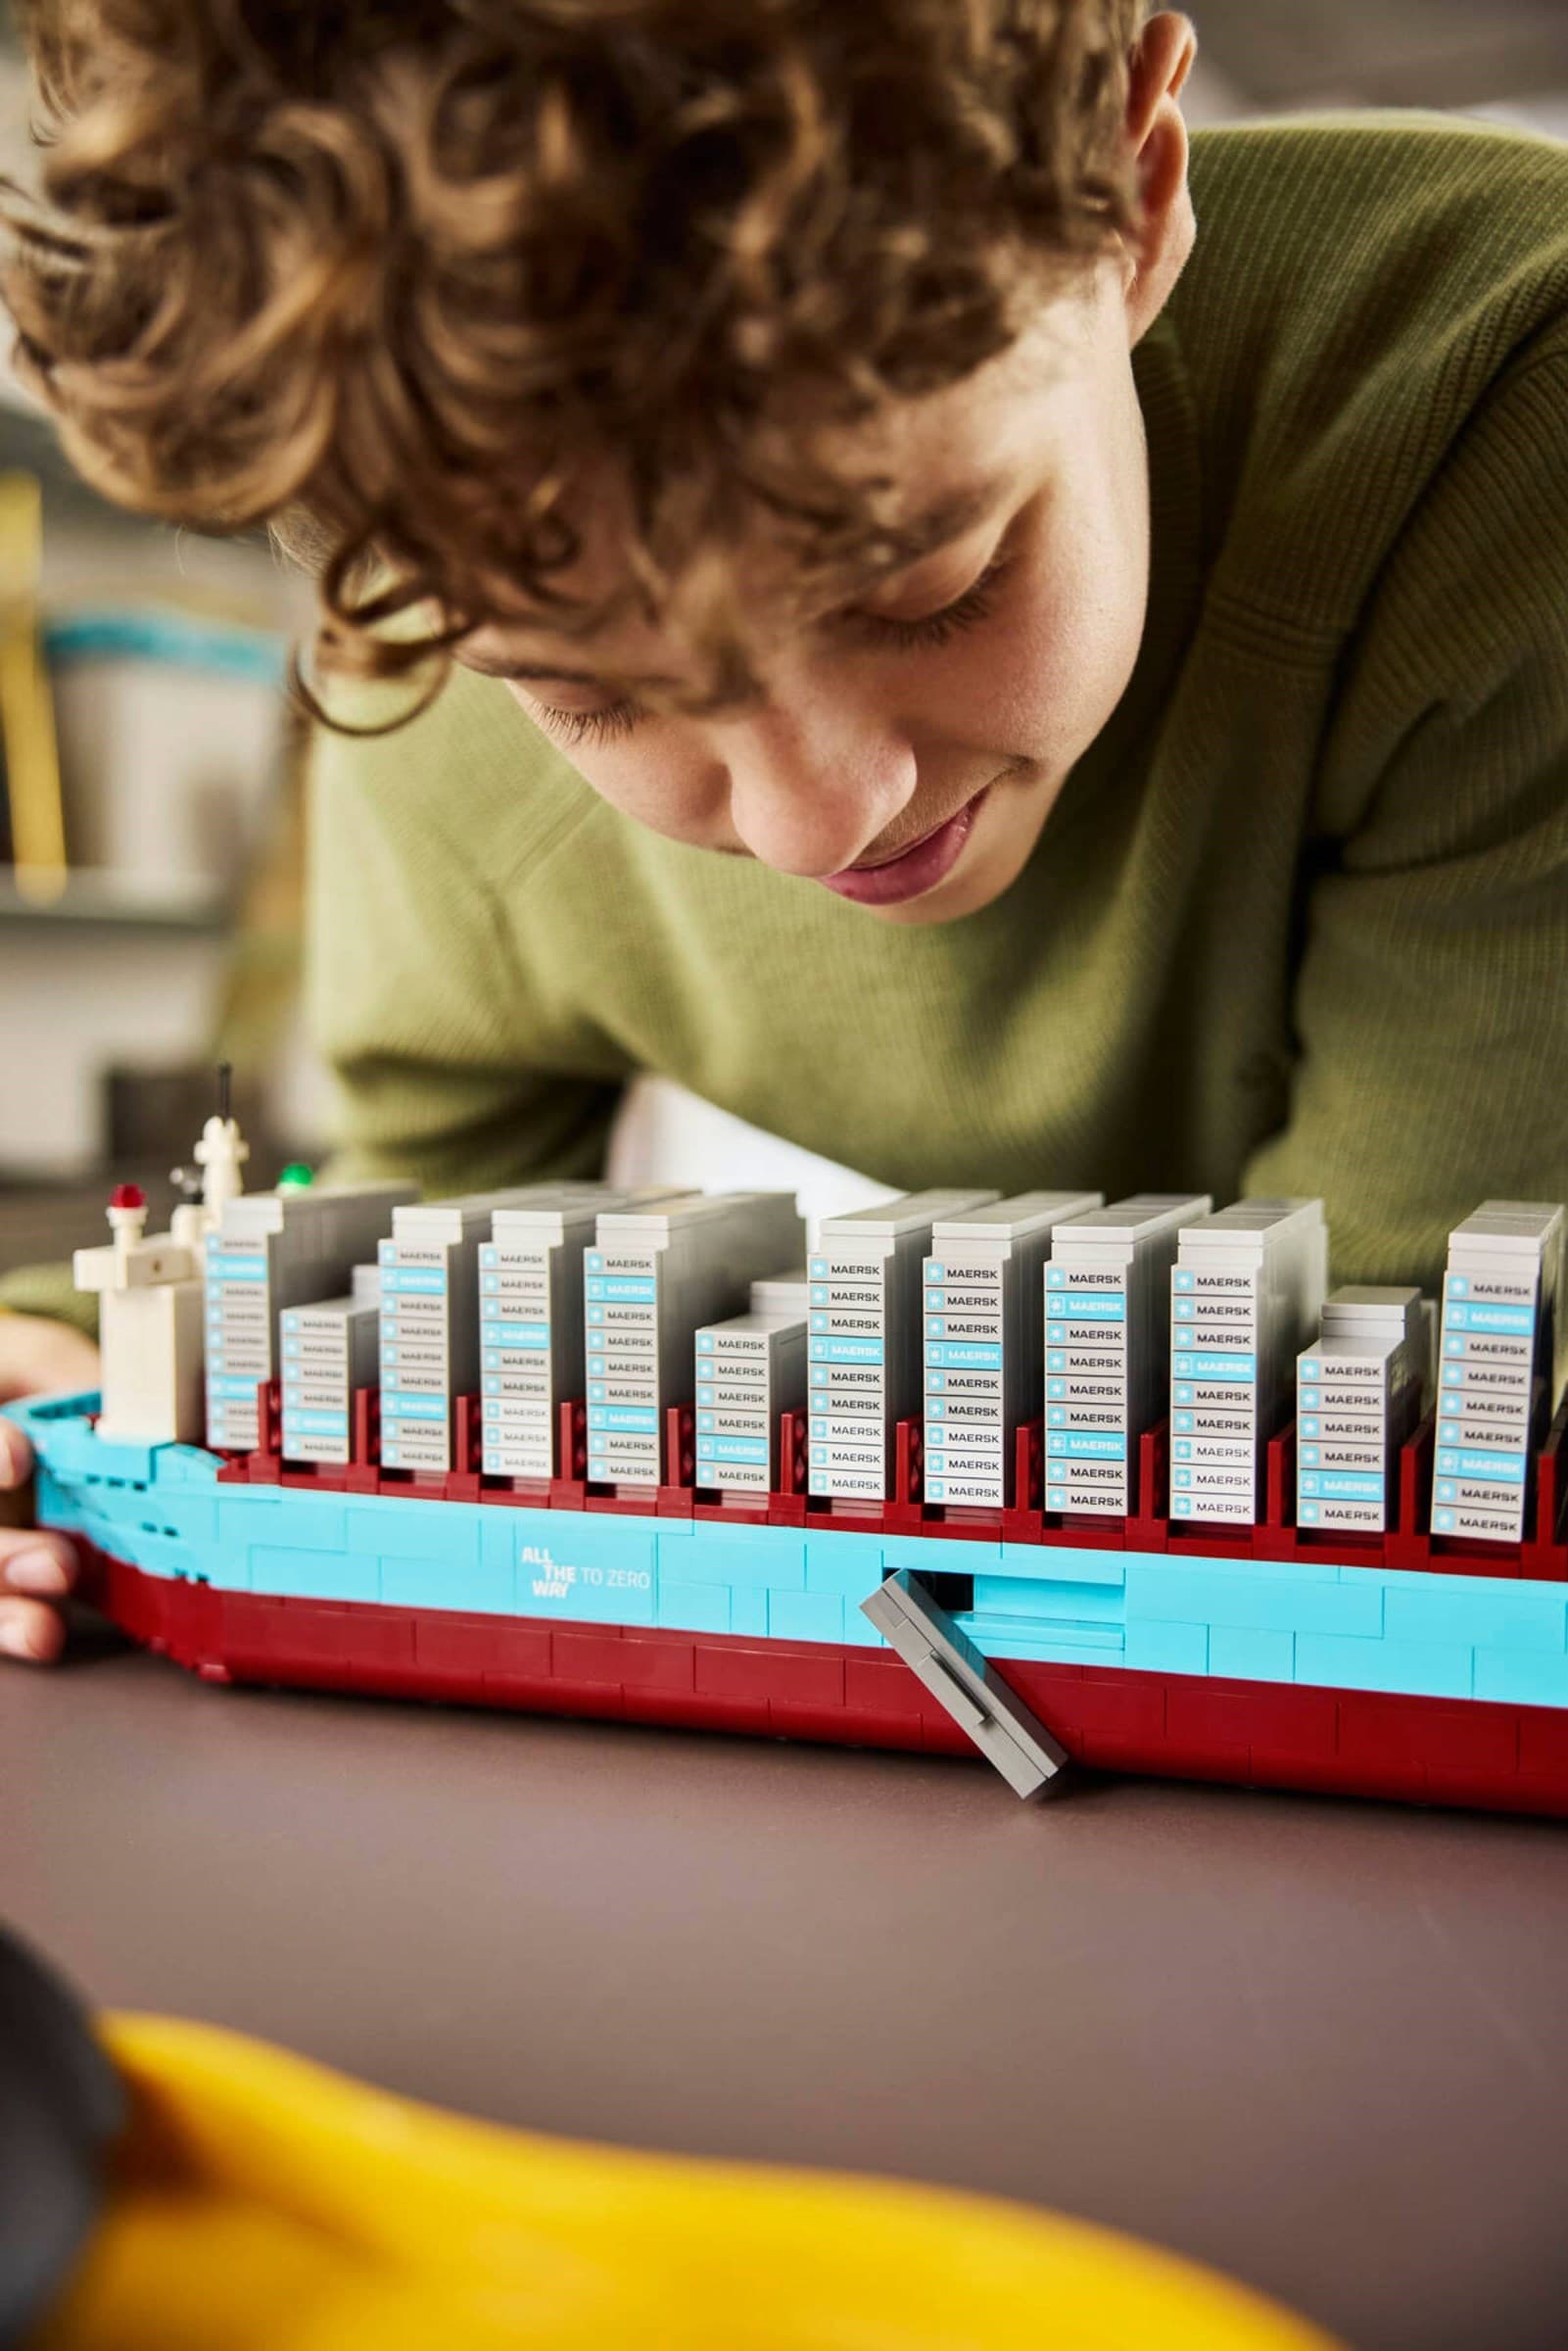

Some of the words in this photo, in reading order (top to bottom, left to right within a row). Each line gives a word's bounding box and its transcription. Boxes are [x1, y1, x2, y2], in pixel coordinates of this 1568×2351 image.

[606, 1260, 652, 1269] MAERSK
[832, 1266, 879, 1274] MAERSK
[947, 1270, 998, 1278] MAERSK
[1069, 1274, 1121, 1284] MAERSK
[1197, 1277, 1251, 1287] MAERSK
[1474, 1284, 1530, 1296] MAERSK
[832, 1292, 879, 1302] MAERSK
[948, 1297, 998, 1307] MAERSK
[1069, 1301, 1121, 1312] MAERSK
[1197, 1306, 1251, 1316] MAERSK
[607, 1312, 652, 1321] MAERSK
[832, 1319, 879, 1329] MAERSK
[948, 1324, 998, 1334] MAERSK
[1069, 1330, 1121, 1340] MAERSK
[1197, 1334, 1251, 1344] MAERSK
[608, 1337, 652, 1347] MAERSK
[718, 1340, 765, 1350] MAERSK
[832, 1346, 880, 1357] MAERSK
[1470, 1343, 1528, 1355] MAERSK
[948, 1351, 998, 1361] MAERSK
[1069, 1358, 1121, 1367] MAERSK
[1198, 1361, 1252, 1372] MAERSK
[608, 1363, 653, 1373] MAERSK
[718, 1367, 765, 1376] MAERSK
[1325, 1367, 1380, 1376] MAERSK
[832, 1372, 880, 1383] MAERSK
[1468, 1372, 1525, 1384] MAERSK
[948, 1379, 998, 1388] MAERSK
[608, 1389, 654, 1399] MAERSK
[1069, 1385, 1121, 1396] MAERSK
[719, 1393, 765, 1403] MAERSK
[1197, 1391, 1251, 1401] MAERSK
[1325, 1395, 1380, 1405] MAERSK
[832, 1400, 880, 1410] MAERSK
[1466, 1402, 1524, 1415] MAERSK
[948, 1406, 998, 1416] MAERSK
[1070, 1414, 1121, 1423] MAERSK
[719, 1419, 765, 1429] MAERSK
[1197, 1419, 1251, 1430] MAERSK
[1325, 1423, 1380, 1434] MAERSK
[832, 1426, 880, 1436] MAERSK
[949, 1433, 999, 1443] MAERSK
[1464, 1430, 1522, 1444] MAERSK
[610, 1441, 655, 1450] MAERSK
[1070, 1440, 1122, 1452] MAERSK
[1197, 1447, 1251, 1458] MAERSK
[832, 1453, 880, 1463] MAERSK
[1325, 1453, 1380, 1463] MAERSK
[949, 1460, 999, 1470] MAERSK
[610, 1465, 655, 1476] MAERSK
[1070, 1468, 1122, 1478] MAERSK
[719, 1471, 765, 1482] MAERSK
[1197, 1475, 1251, 1486] MAERSK
[832, 1479, 880, 1490] MAERSK
[949, 1487, 999, 1498] MAERSK
[1461, 1488, 1519, 1502] MAERSK
[1070, 1496, 1122, 1507] MAERSK
[1197, 1503, 1251, 1514] MAERSK
[1325, 1510, 1379, 1520] MAERSK
[1459, 1517, 1517, 1531] MAERSK
[522, 1547, 553, 1564] ALL
[544, 1565, 576, 1583] THE
[581, 1567, 603, 1585] TO
[607, 1569, 650, 1589] ZERO
[533, 1580, 569, 1599] WAY
